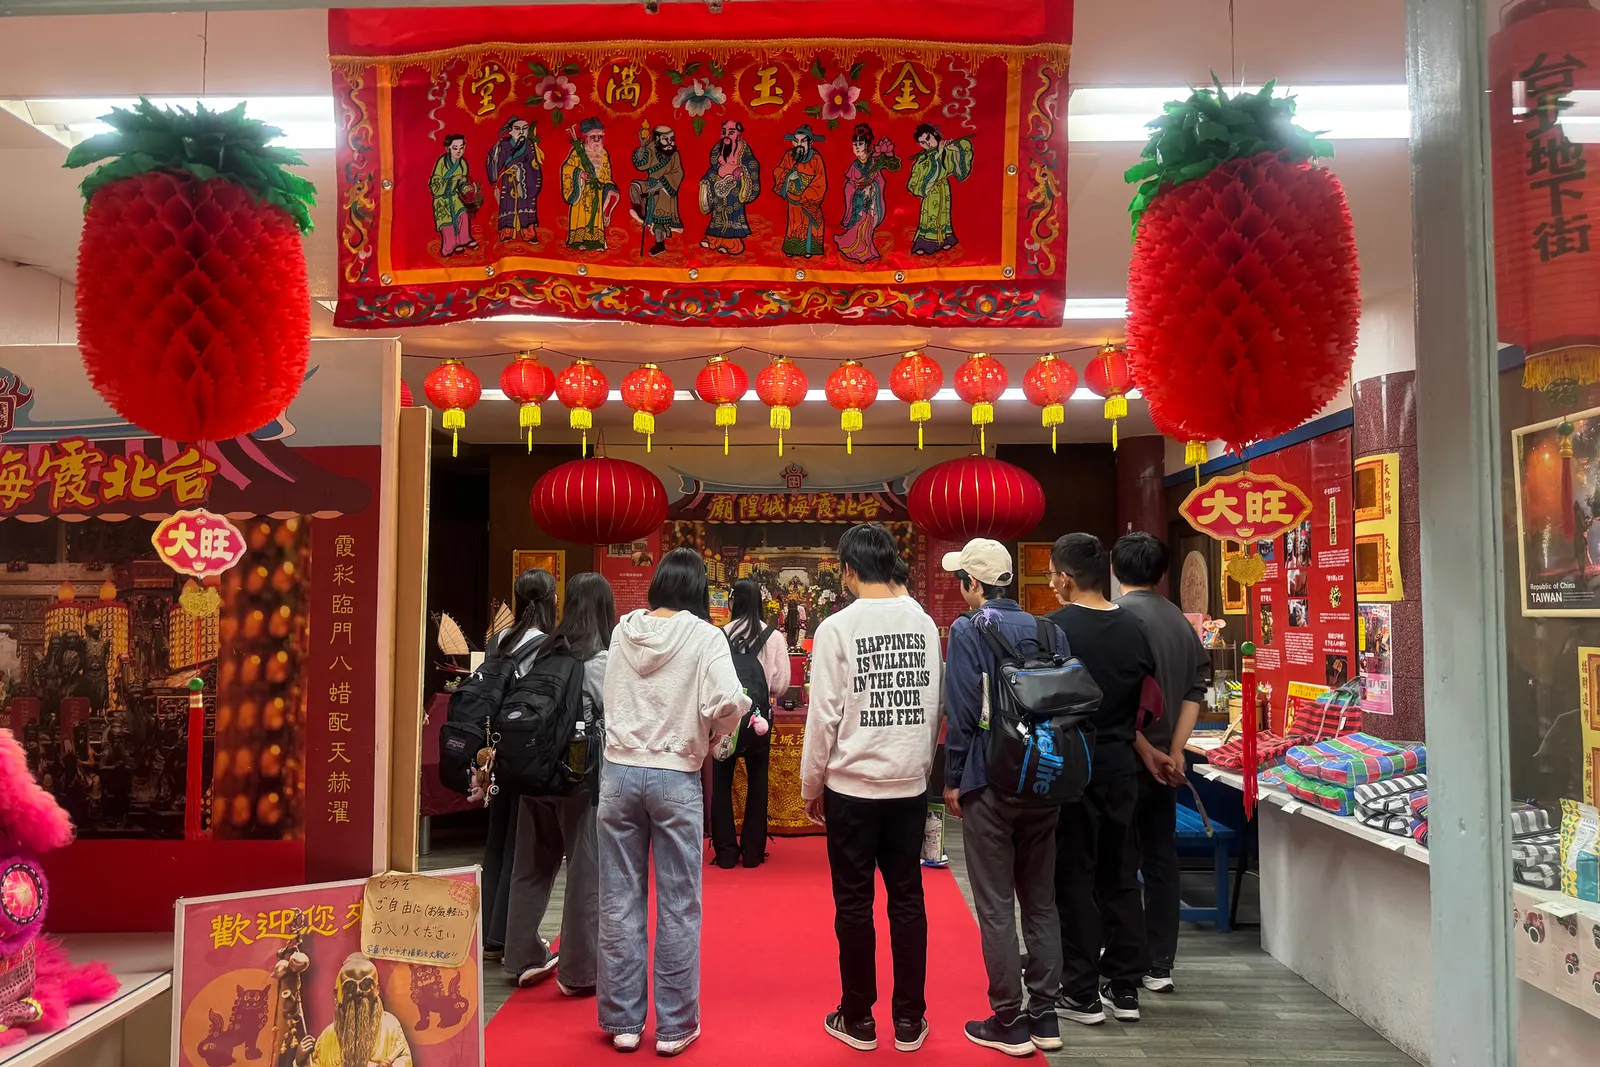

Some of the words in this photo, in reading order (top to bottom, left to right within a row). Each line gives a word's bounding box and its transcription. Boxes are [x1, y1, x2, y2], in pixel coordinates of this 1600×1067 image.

[1196, 489, 1294, 525] 大旺
[164, 522, 234, 561] 大旺
[1530, 583, 1552, 591] Republic
[1530, 592, 1563, 603] TAIWAN
[855, 633, 926, 655] HAPPINESS
[856, 656, 870, 674] IS
[871, 651, 926, 671] WALKING
[853, 675, 868, 693] IN
[868, 671, 894, 689] THE
[895, 670, 930, 688] GRASS
[869, 691, 885, 708] IN
[886, 689, 921, 707] YOUR
[860, 709, 894, 727] BARE
[379, 875, 416, 891] どうぞ
[371, 921, 456, 941] お入りください
